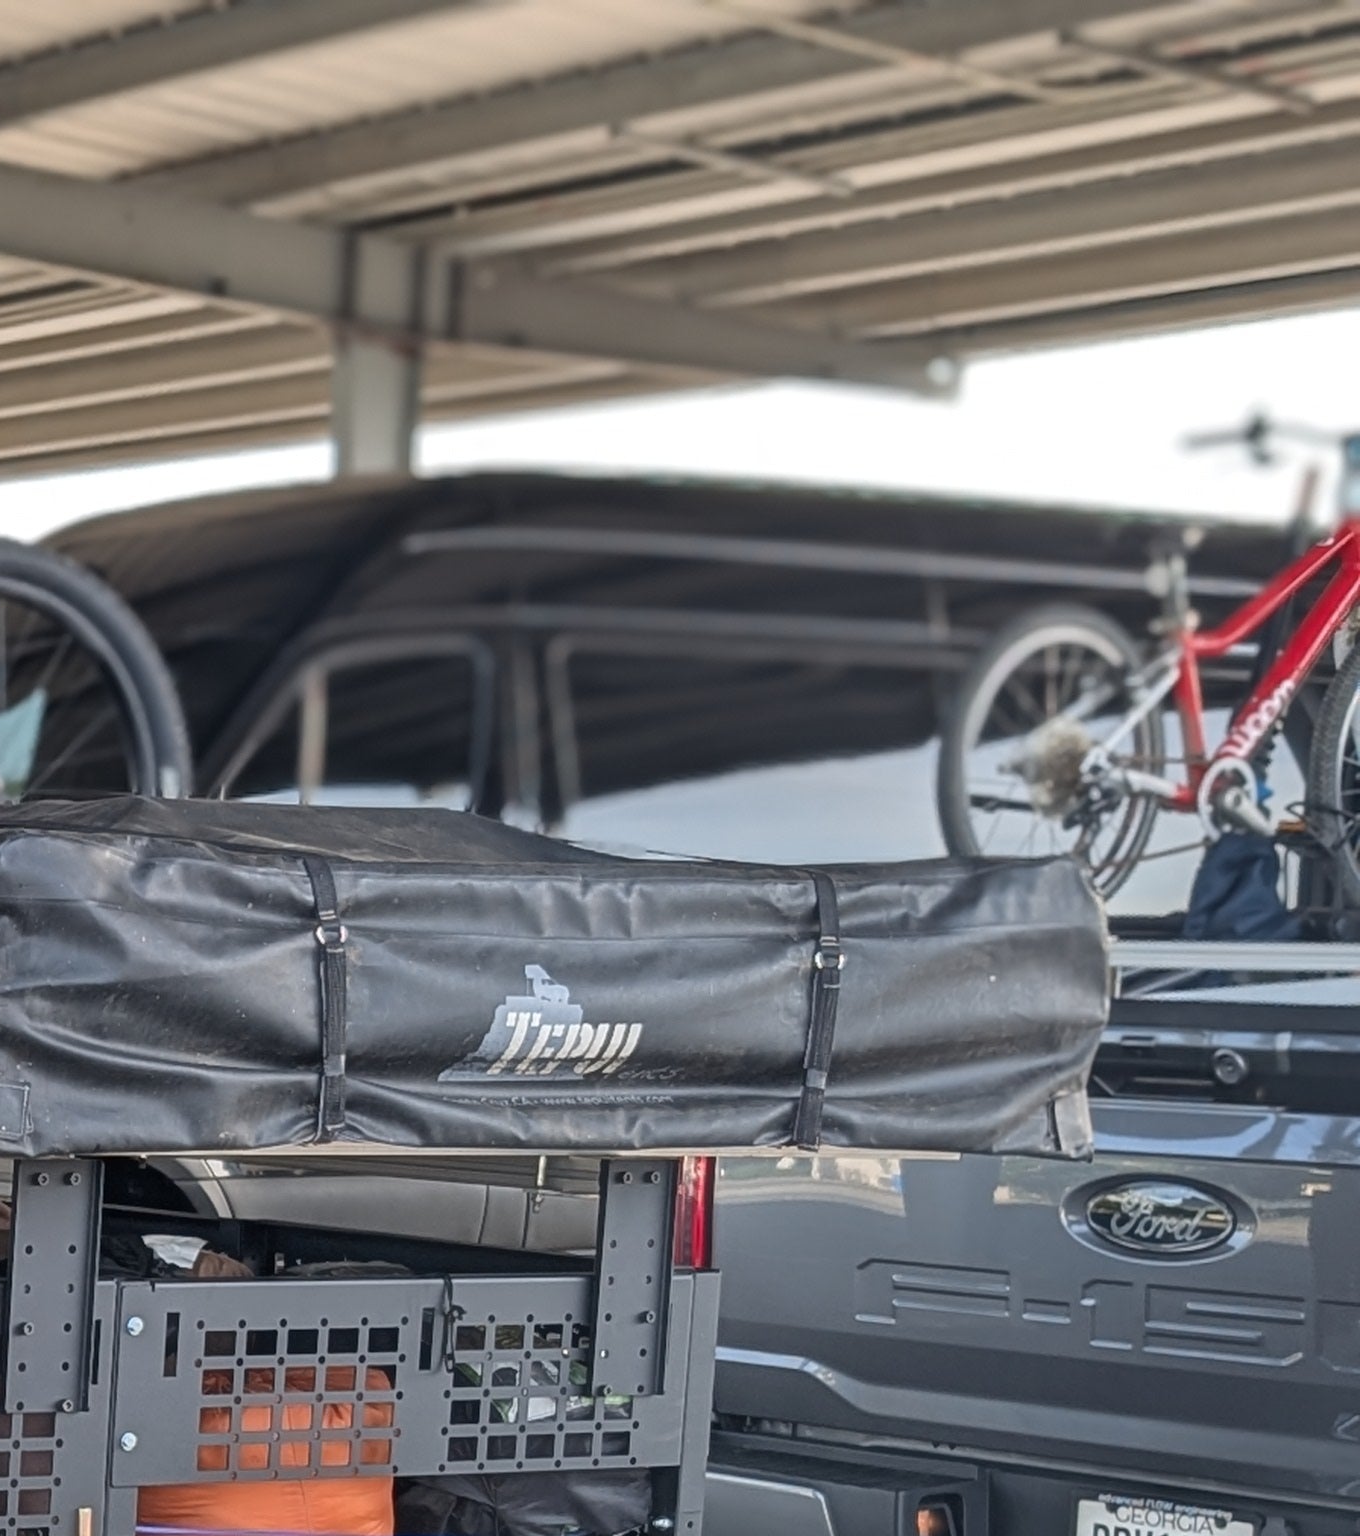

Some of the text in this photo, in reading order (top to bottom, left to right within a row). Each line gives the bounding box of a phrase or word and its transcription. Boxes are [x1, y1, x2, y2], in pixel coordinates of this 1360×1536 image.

[1110, 1193, 1209, 1242] Ford
[855, 1257, 1360, 1374] F-15
[1114, 1504, 1214, 1536] GEORGIA
